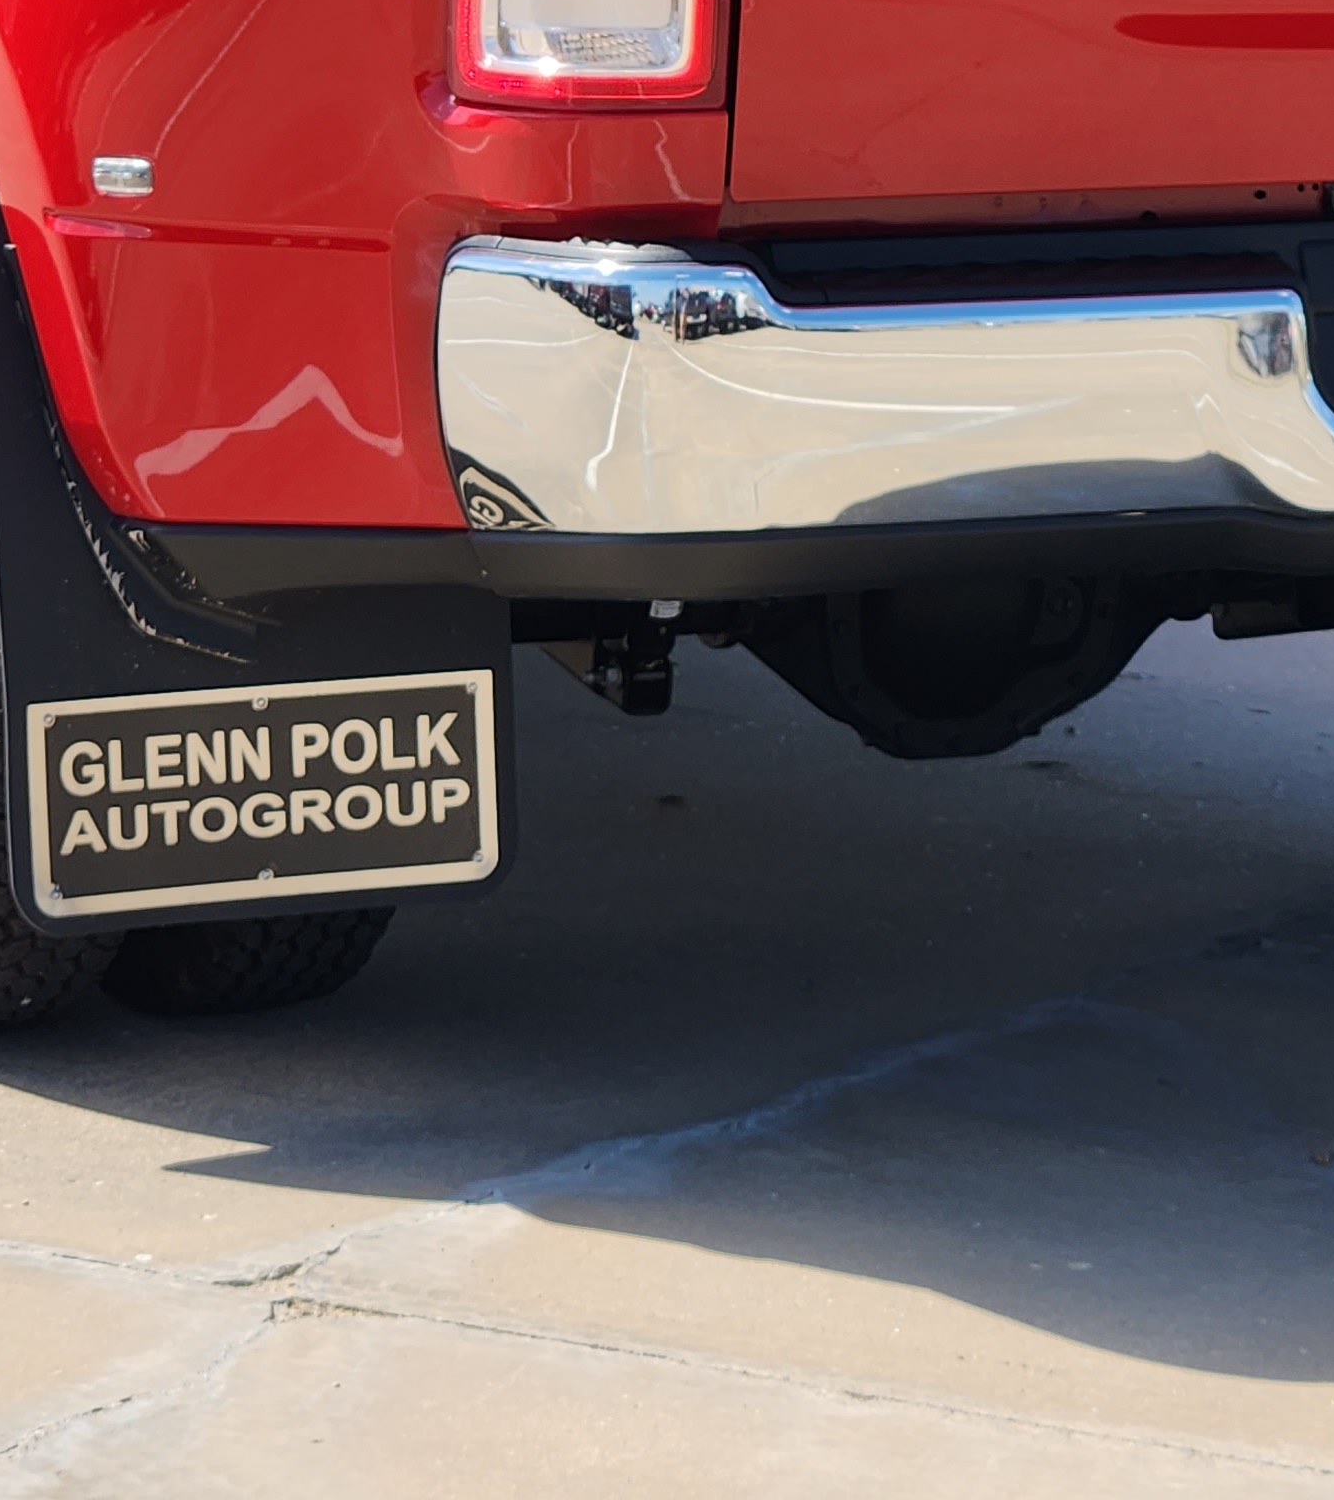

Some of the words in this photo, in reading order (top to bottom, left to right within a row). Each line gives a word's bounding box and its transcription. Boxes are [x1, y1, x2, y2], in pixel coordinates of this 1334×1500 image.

[60, 726, 271, 797] GLENN
[291, 712, 461, 779] POLK
[60, 778, 471, 856] AUTOGROUP
